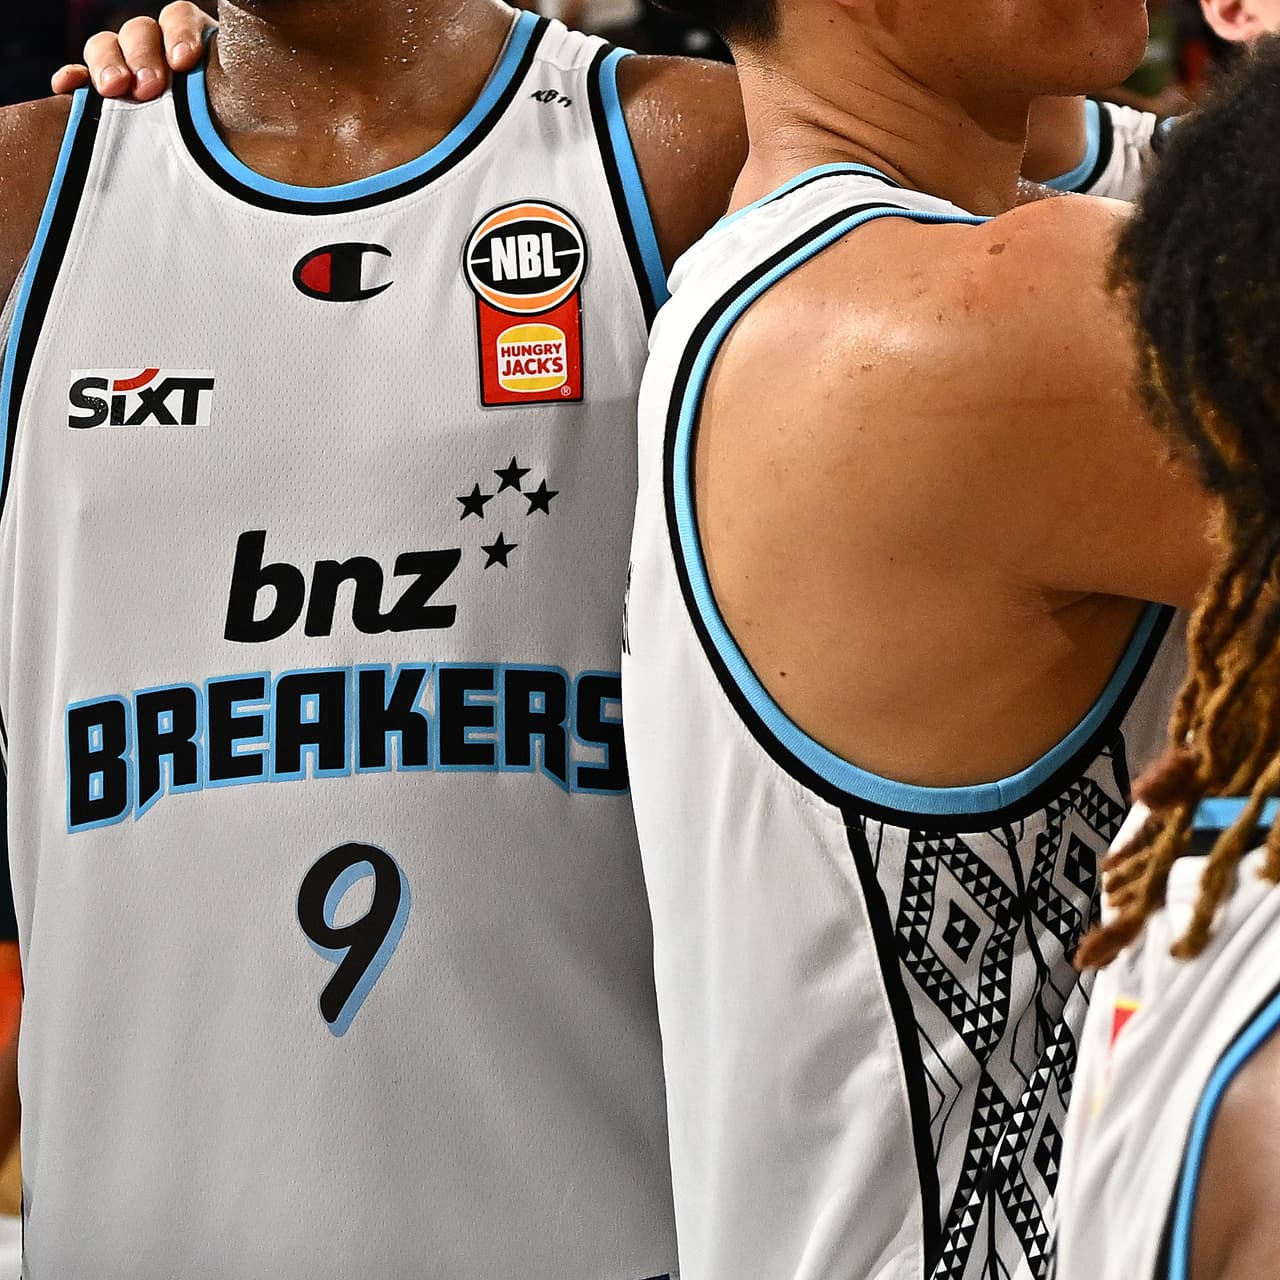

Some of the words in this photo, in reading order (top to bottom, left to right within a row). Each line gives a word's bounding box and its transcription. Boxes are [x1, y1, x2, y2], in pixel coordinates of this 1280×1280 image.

[490, 232, 561, 282] NBL
[500, 343, 562, 358] HUNGRY
[502, 356, 564, 377] JACK'S
[224, 529, 462, 643] bnz
[66, 662, 631, 834] BREAKERS
[295, 840, 411, 1038] 9
